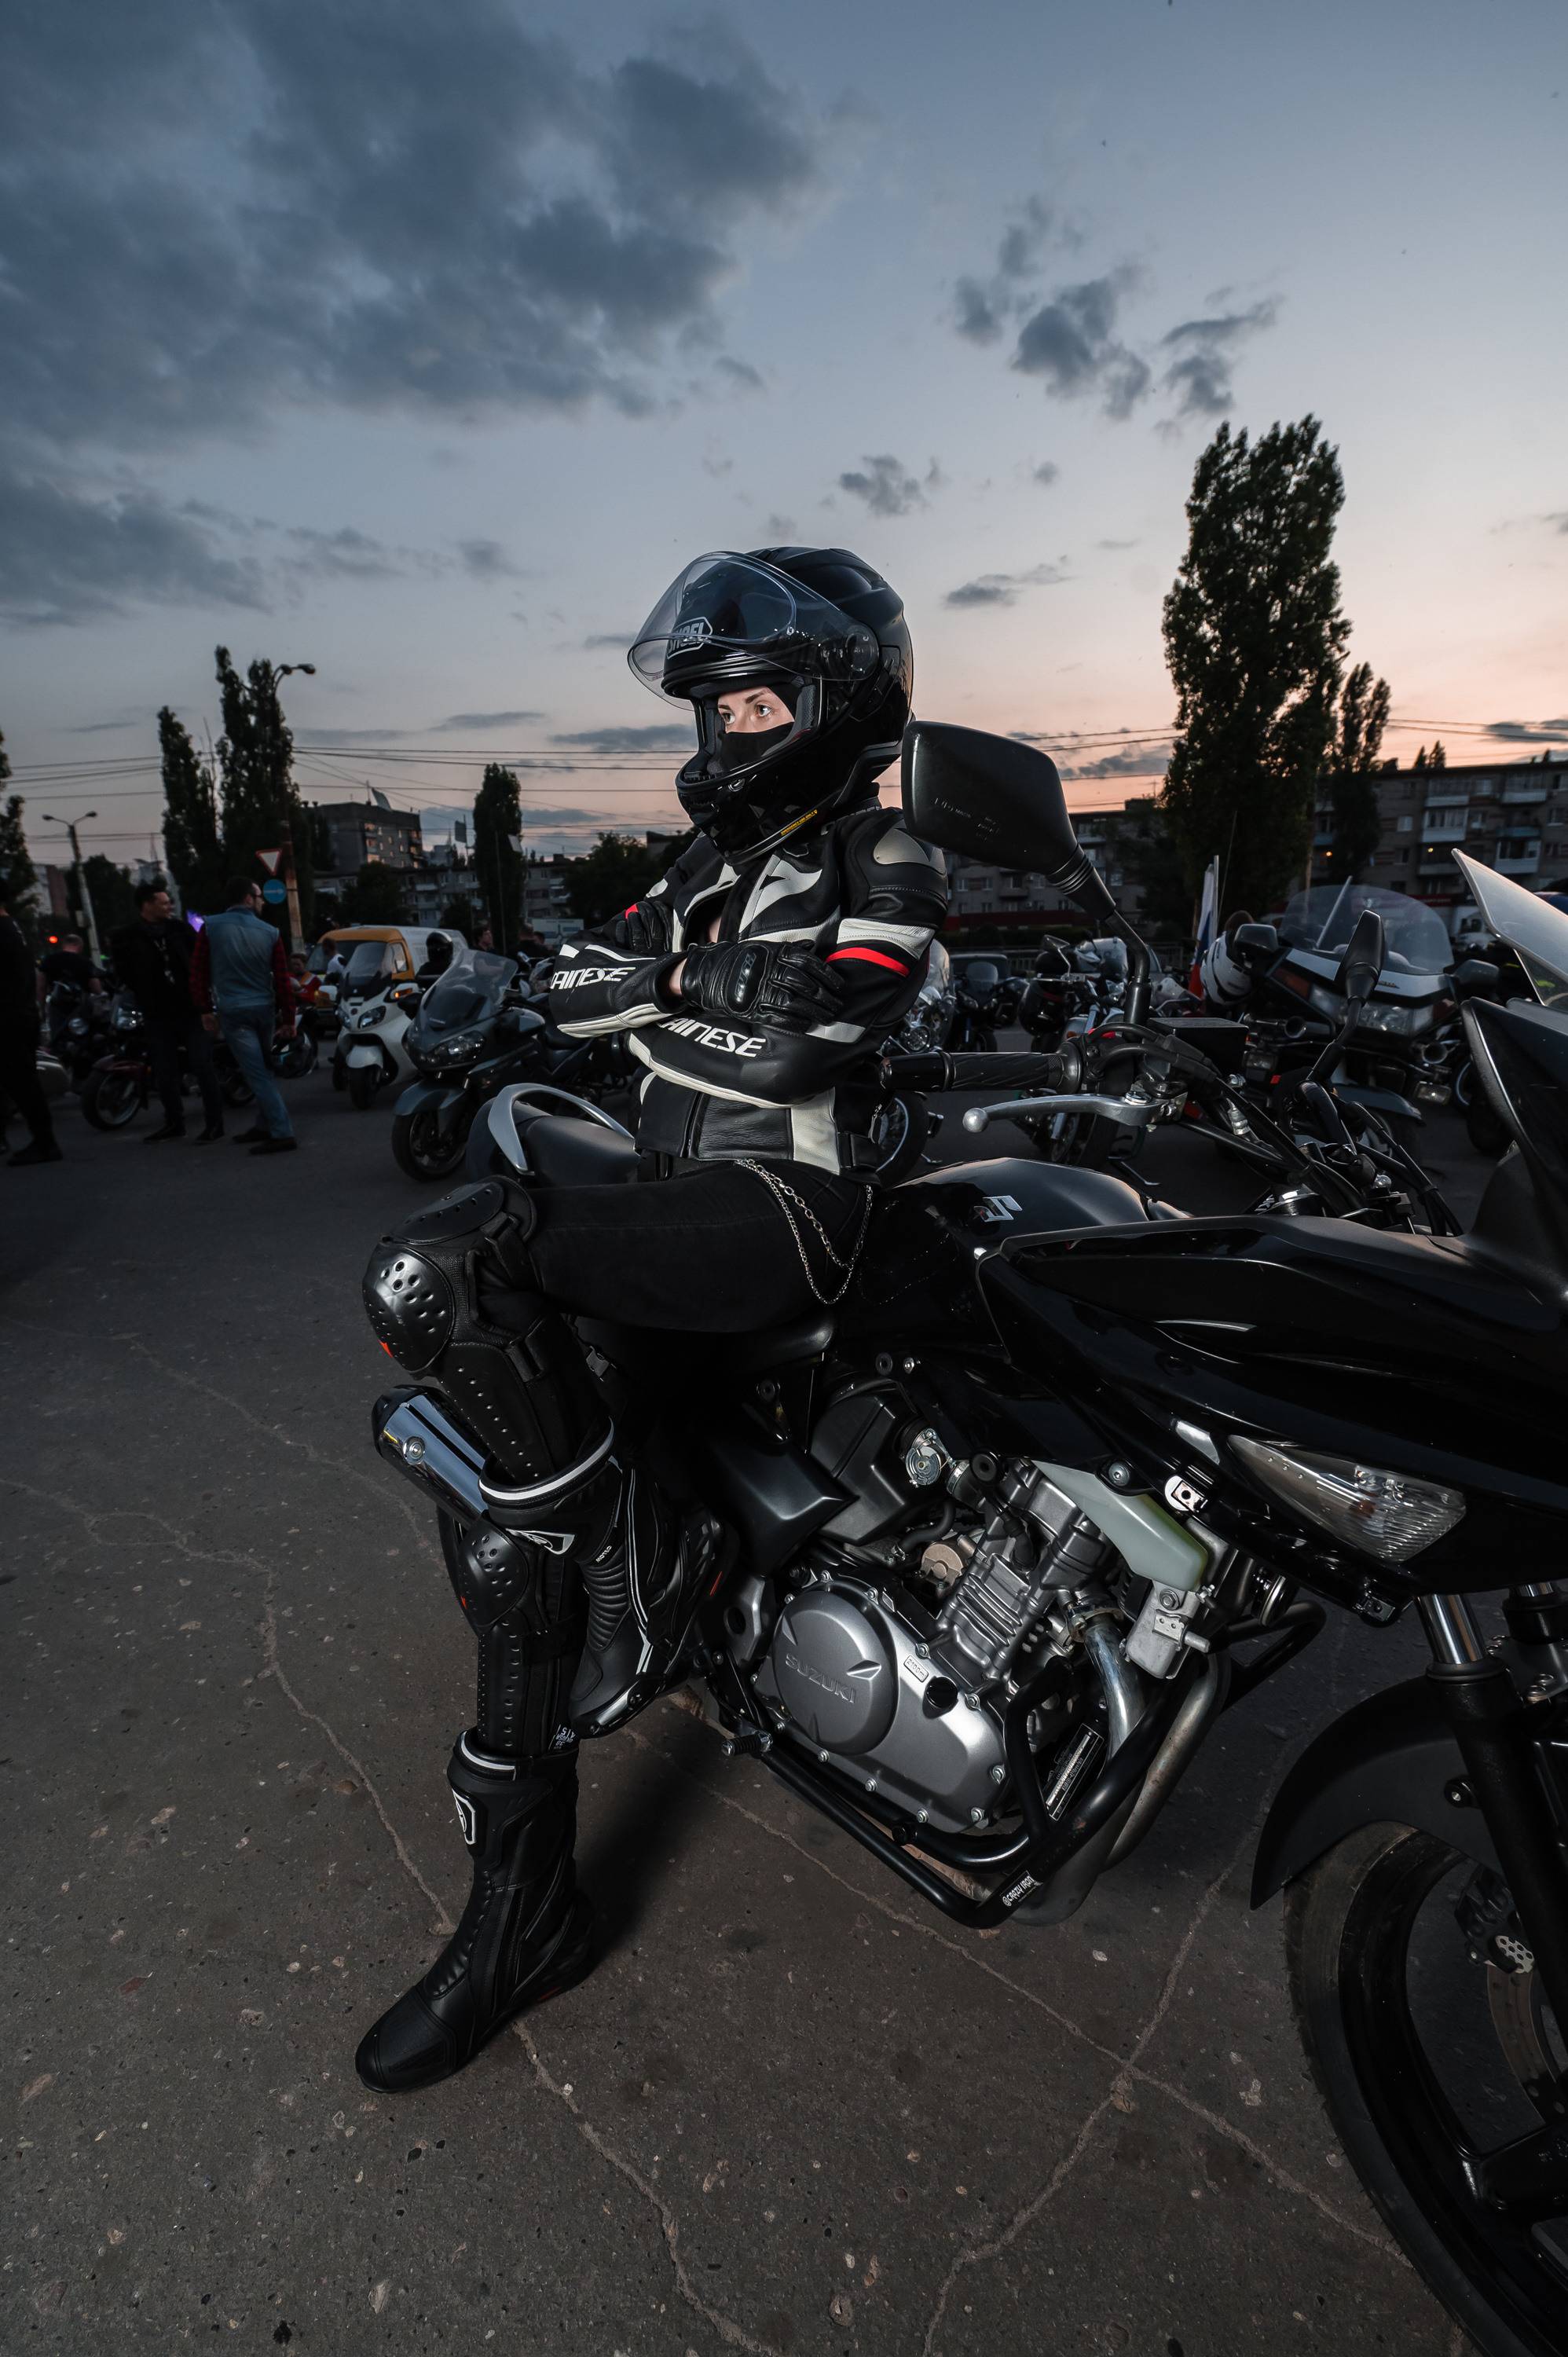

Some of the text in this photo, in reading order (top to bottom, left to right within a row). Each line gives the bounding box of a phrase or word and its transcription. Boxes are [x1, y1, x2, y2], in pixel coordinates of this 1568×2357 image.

[550, 966, 636, 990] AINESE
[657, 1017, 766, 1058] AINESE
[786, 1652, 856, 1704] SUZUKI
[1006, 1884, 1025, 1902] CRAZY
